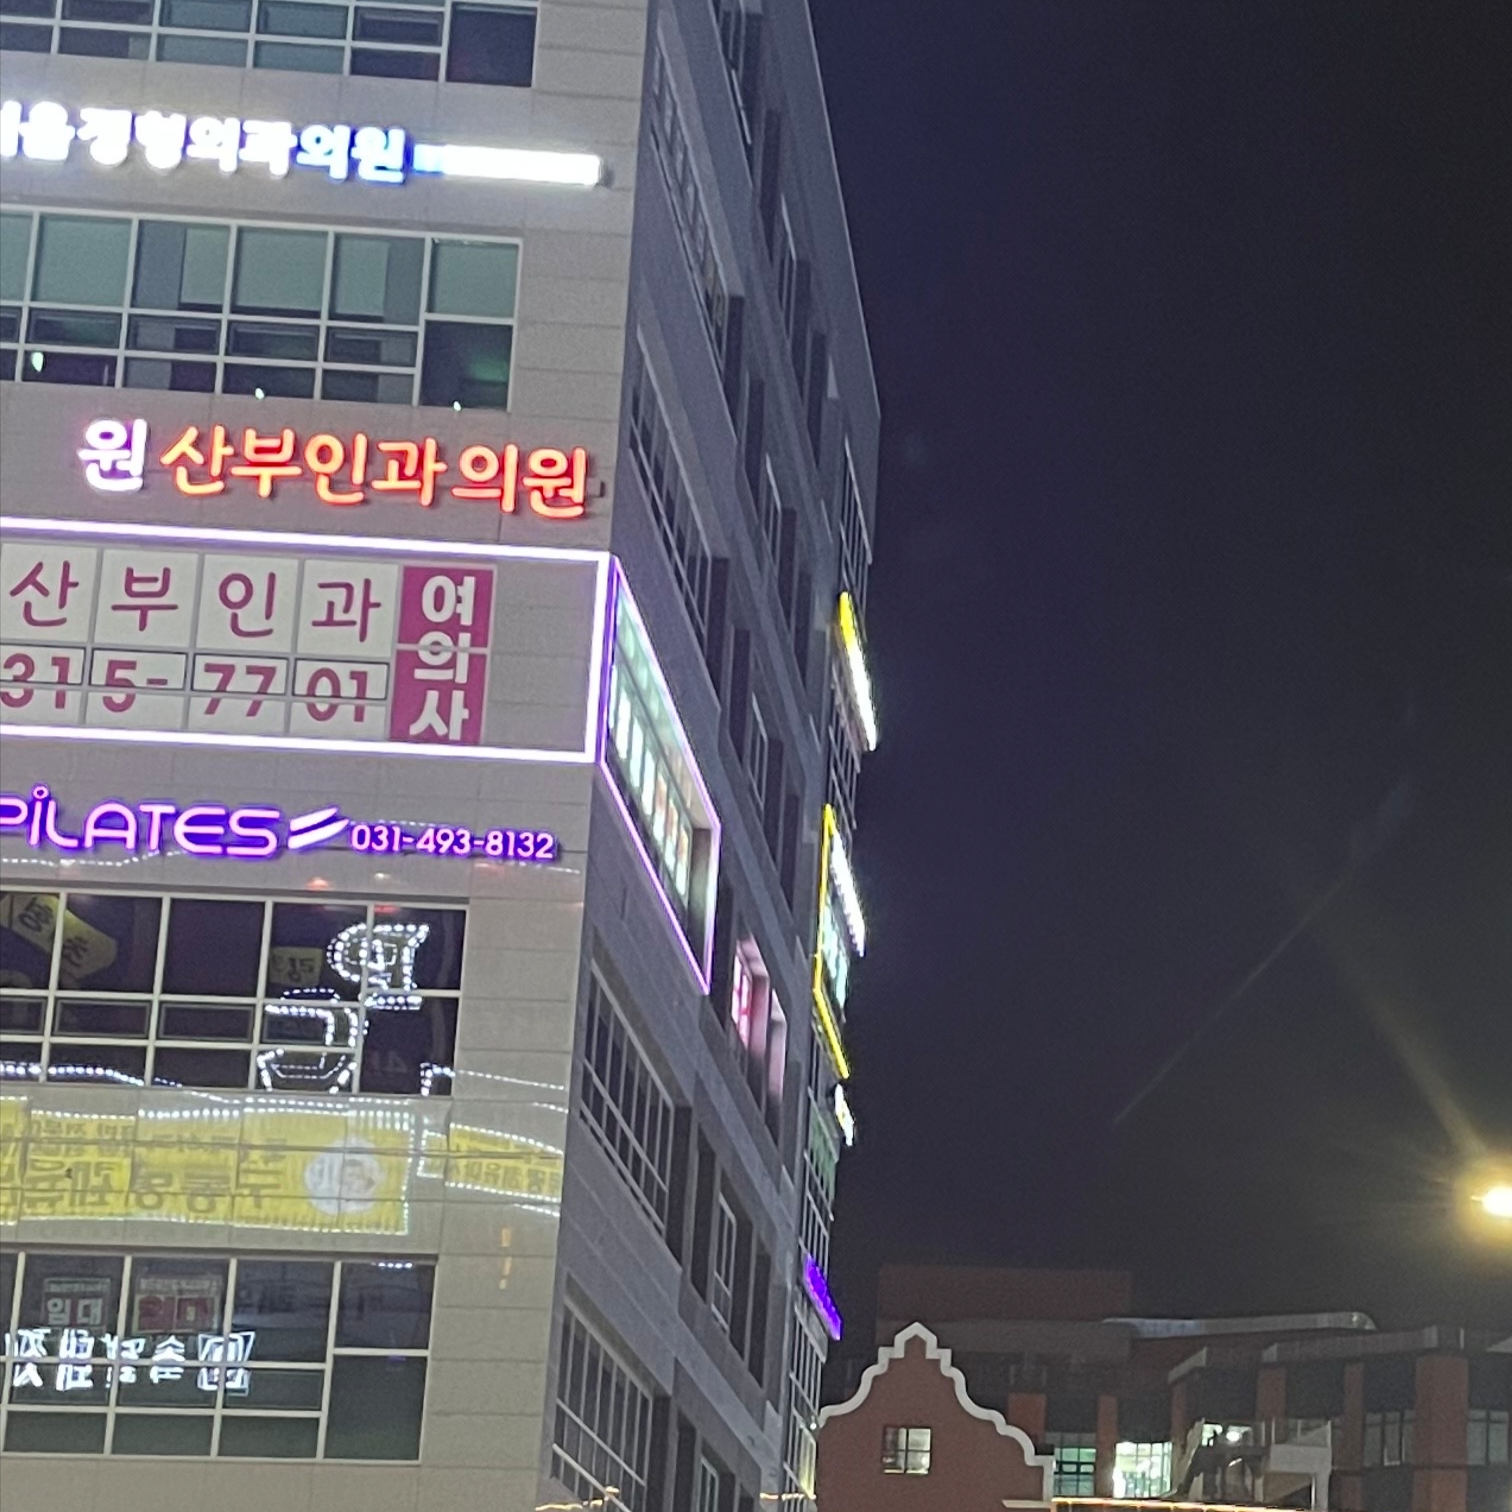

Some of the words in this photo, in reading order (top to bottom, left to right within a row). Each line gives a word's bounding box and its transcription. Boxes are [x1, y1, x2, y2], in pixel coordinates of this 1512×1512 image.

[79, 419, 147, 492] 원
[159, 425, 588, 519] 산부인과의원
[9, 560, 382, 642] 산부인과
[409, 574, 477, 741] 여의사
[350, 823, 555, 860] 031-493-8132
